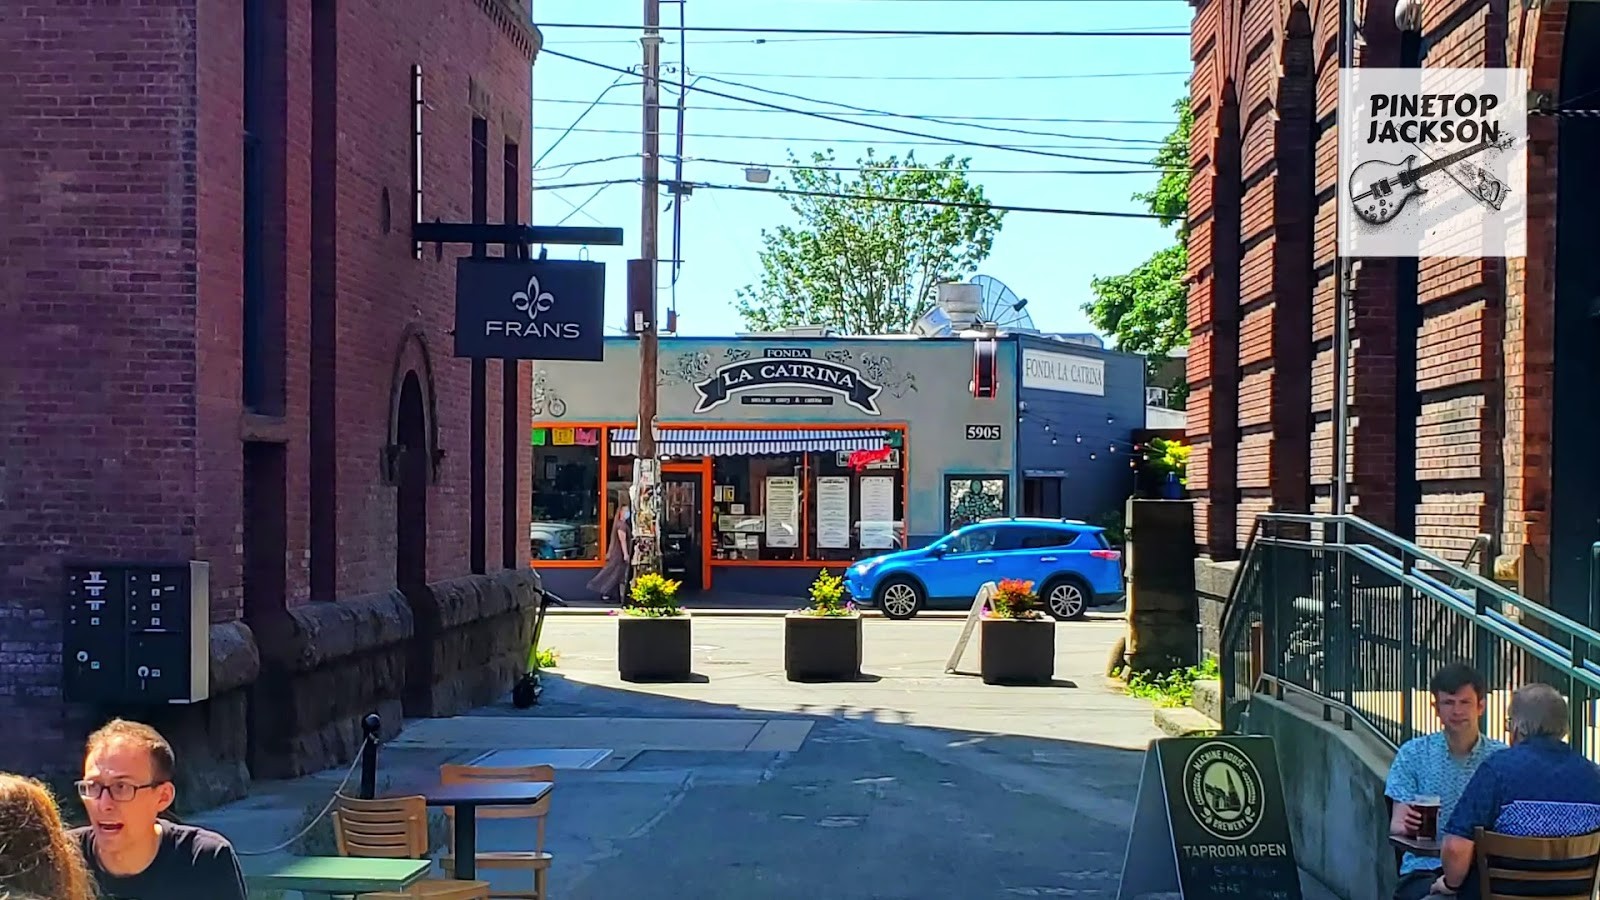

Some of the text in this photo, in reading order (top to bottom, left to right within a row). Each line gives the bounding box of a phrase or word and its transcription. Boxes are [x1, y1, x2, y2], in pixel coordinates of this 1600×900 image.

[485, 321, 580, 339] FRAN'S
[767, 349, 809, 358] FONDA
[722, 364, 854, 388] LA CATRINA
[1025, 358, 1102, 387] FONDA LA CATRINA
[967, 426, 1000, 439] 5905
[1192, 750, 1248, 771] MACHINE HOUSE
[1212, 819, 1249, 831] BREWERY
[1183, 844, 1287, 858] TAPROOM OPEN
